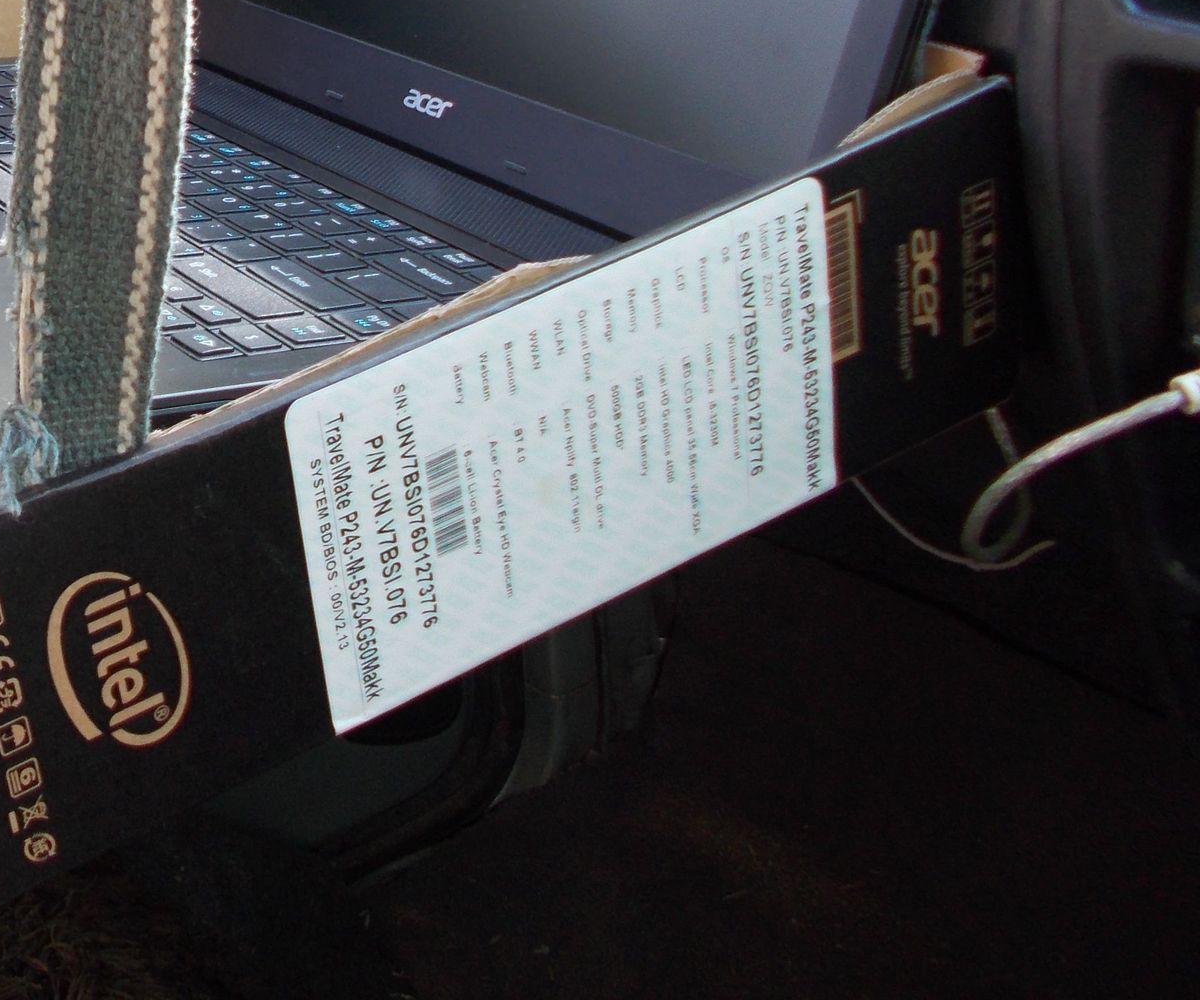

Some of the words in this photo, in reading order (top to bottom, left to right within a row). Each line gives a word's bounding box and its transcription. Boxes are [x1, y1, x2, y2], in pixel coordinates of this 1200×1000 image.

[403, 88, 453, 119] acer
[774, 214, 787, 243] P/N
[794, 202, 813, 301] TravelMate
[911, 229, 941, 337] acer
[528, 328, 541, 371] WWAN
[552, 318, 565, 357] WLAN
[324, 411, 354, 511] TravelMate
[363, 433, 387, 475] P/N
[309, 457, 330, 520] SYSTEM
[318, 521, 339, 582] BD/BIOS
[394, 414, 438, 629] UNV7BSI076D1273776
[338, 509, 384, 703] P243-M-53234G50Makk
[84, 583, 166, 729] intel
